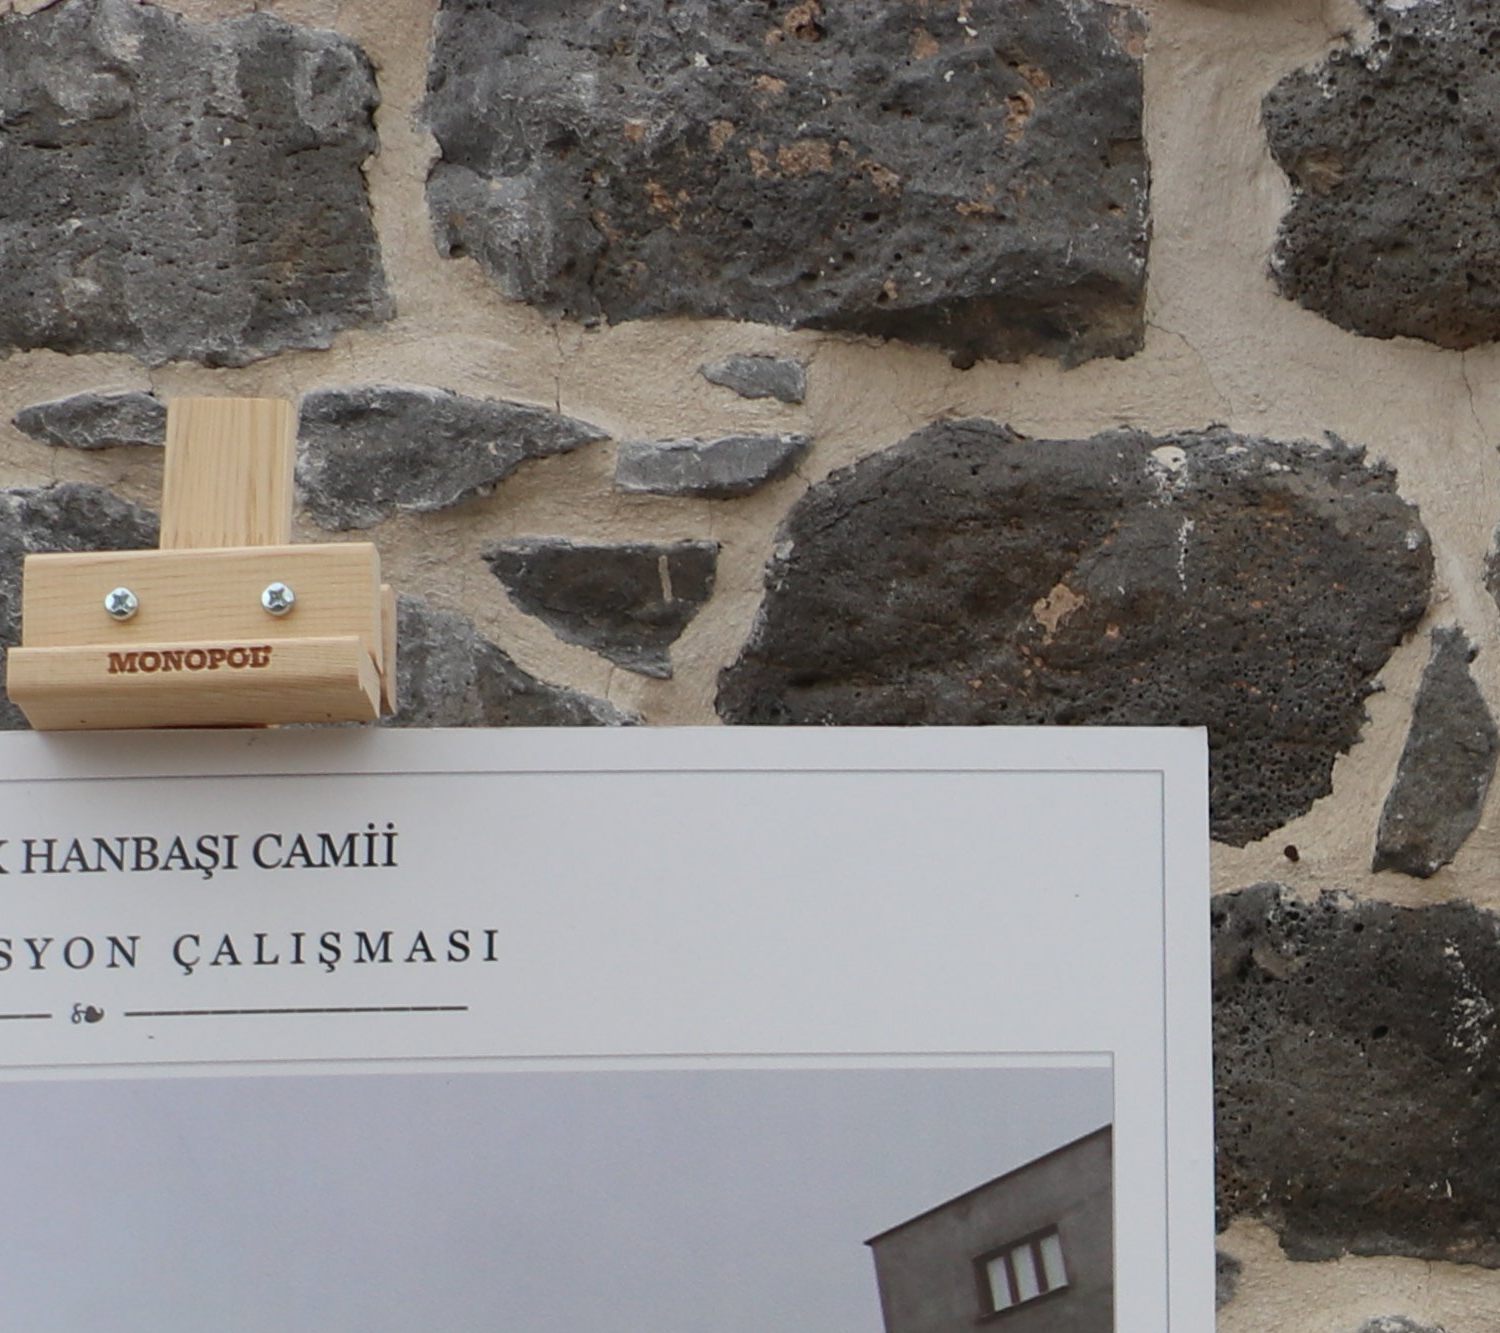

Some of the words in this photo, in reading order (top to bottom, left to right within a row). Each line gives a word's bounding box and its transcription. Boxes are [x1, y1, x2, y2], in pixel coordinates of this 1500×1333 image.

[21, 834, 240, 881] HANBAŞI
[251, 821, 399, 870] CAMİİ
[172, 929, 500, 976] ÇALIŞMASI
